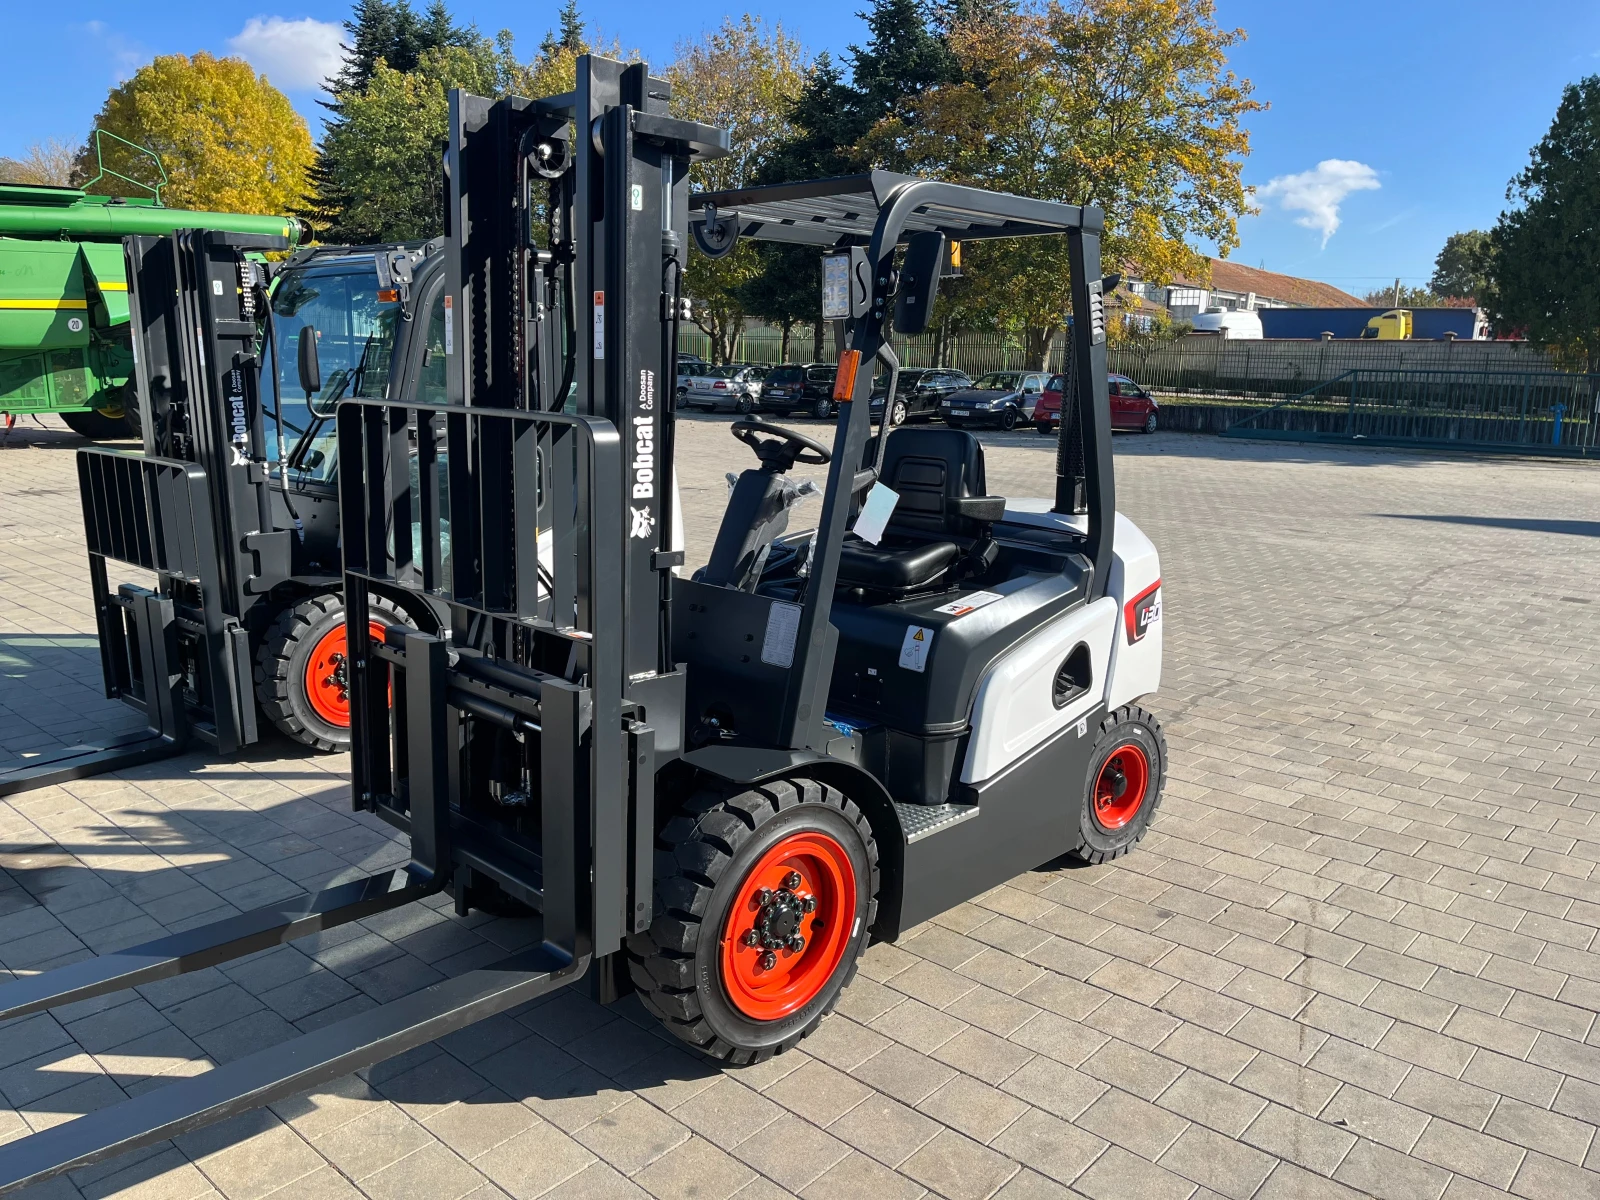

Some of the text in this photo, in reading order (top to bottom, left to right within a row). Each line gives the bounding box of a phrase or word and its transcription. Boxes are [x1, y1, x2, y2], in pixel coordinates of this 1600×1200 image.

[71, 320, 80, 330] 20
[639, 402, 646, 410] A
[646, 370, 655, 410] Company
[229, 395, 248, 443] Bobcat
[632, 416, 654, 499] Bobcat
[1140, 602, 1161, 627] D30
